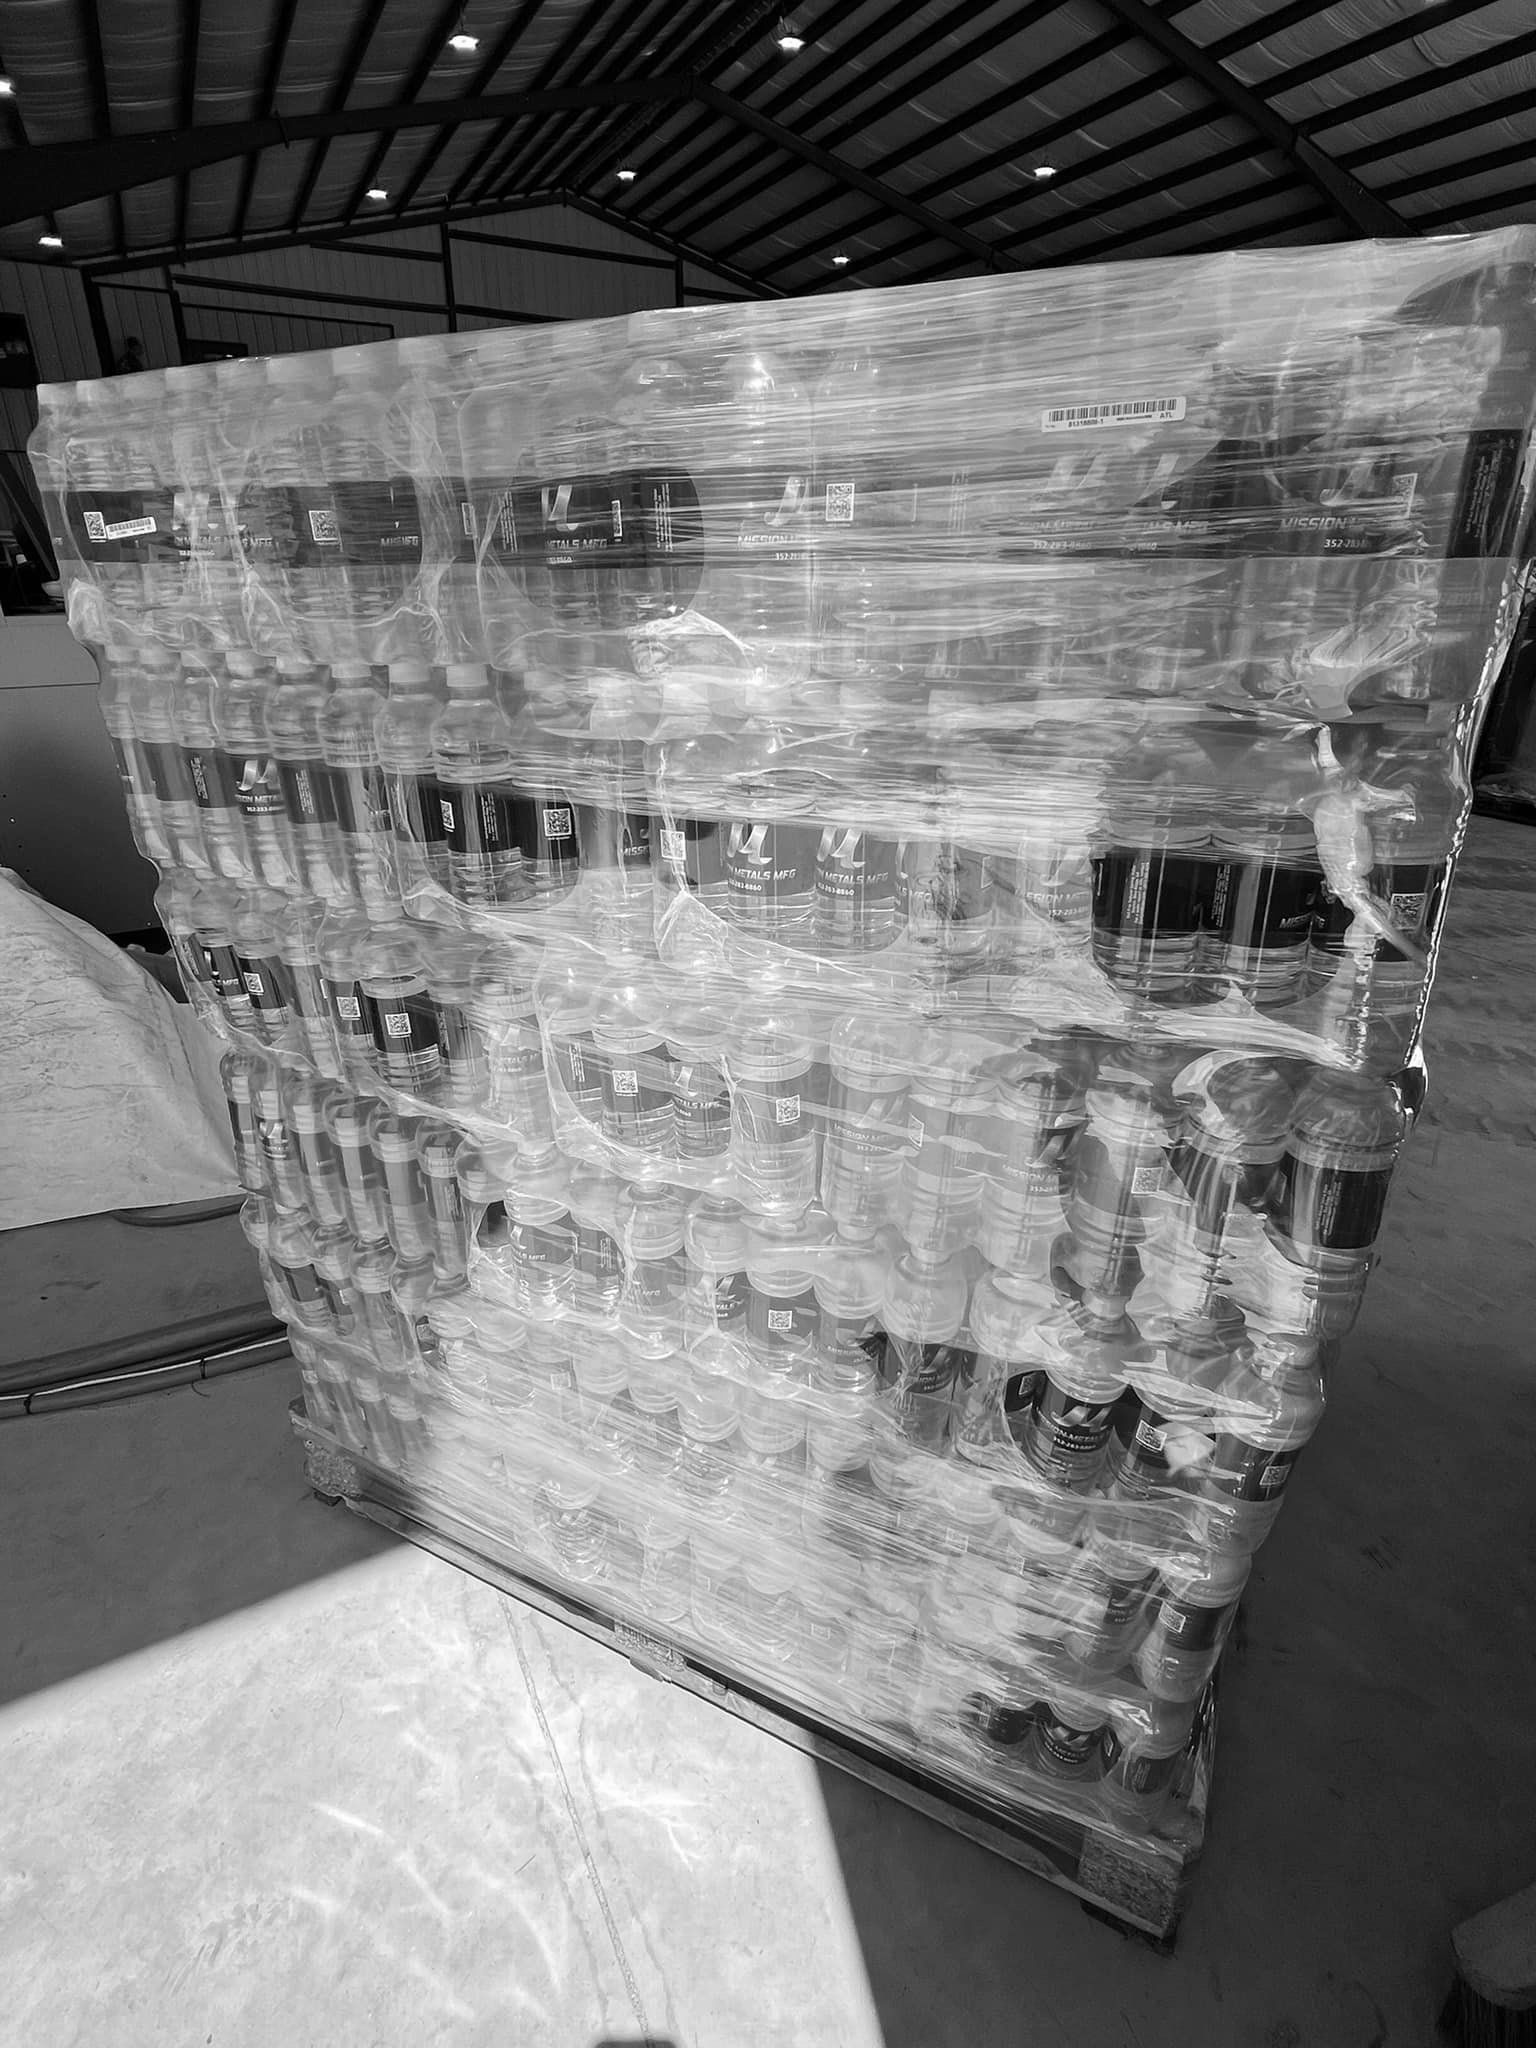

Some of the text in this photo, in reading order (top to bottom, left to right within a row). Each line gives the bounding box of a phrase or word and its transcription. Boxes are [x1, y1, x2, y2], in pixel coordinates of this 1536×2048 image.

[1280, 516, 1347, 530] MISSION
[734, 866, 797, 880] METALS MFG
[824, 871, 889, 885] METALS MFG
